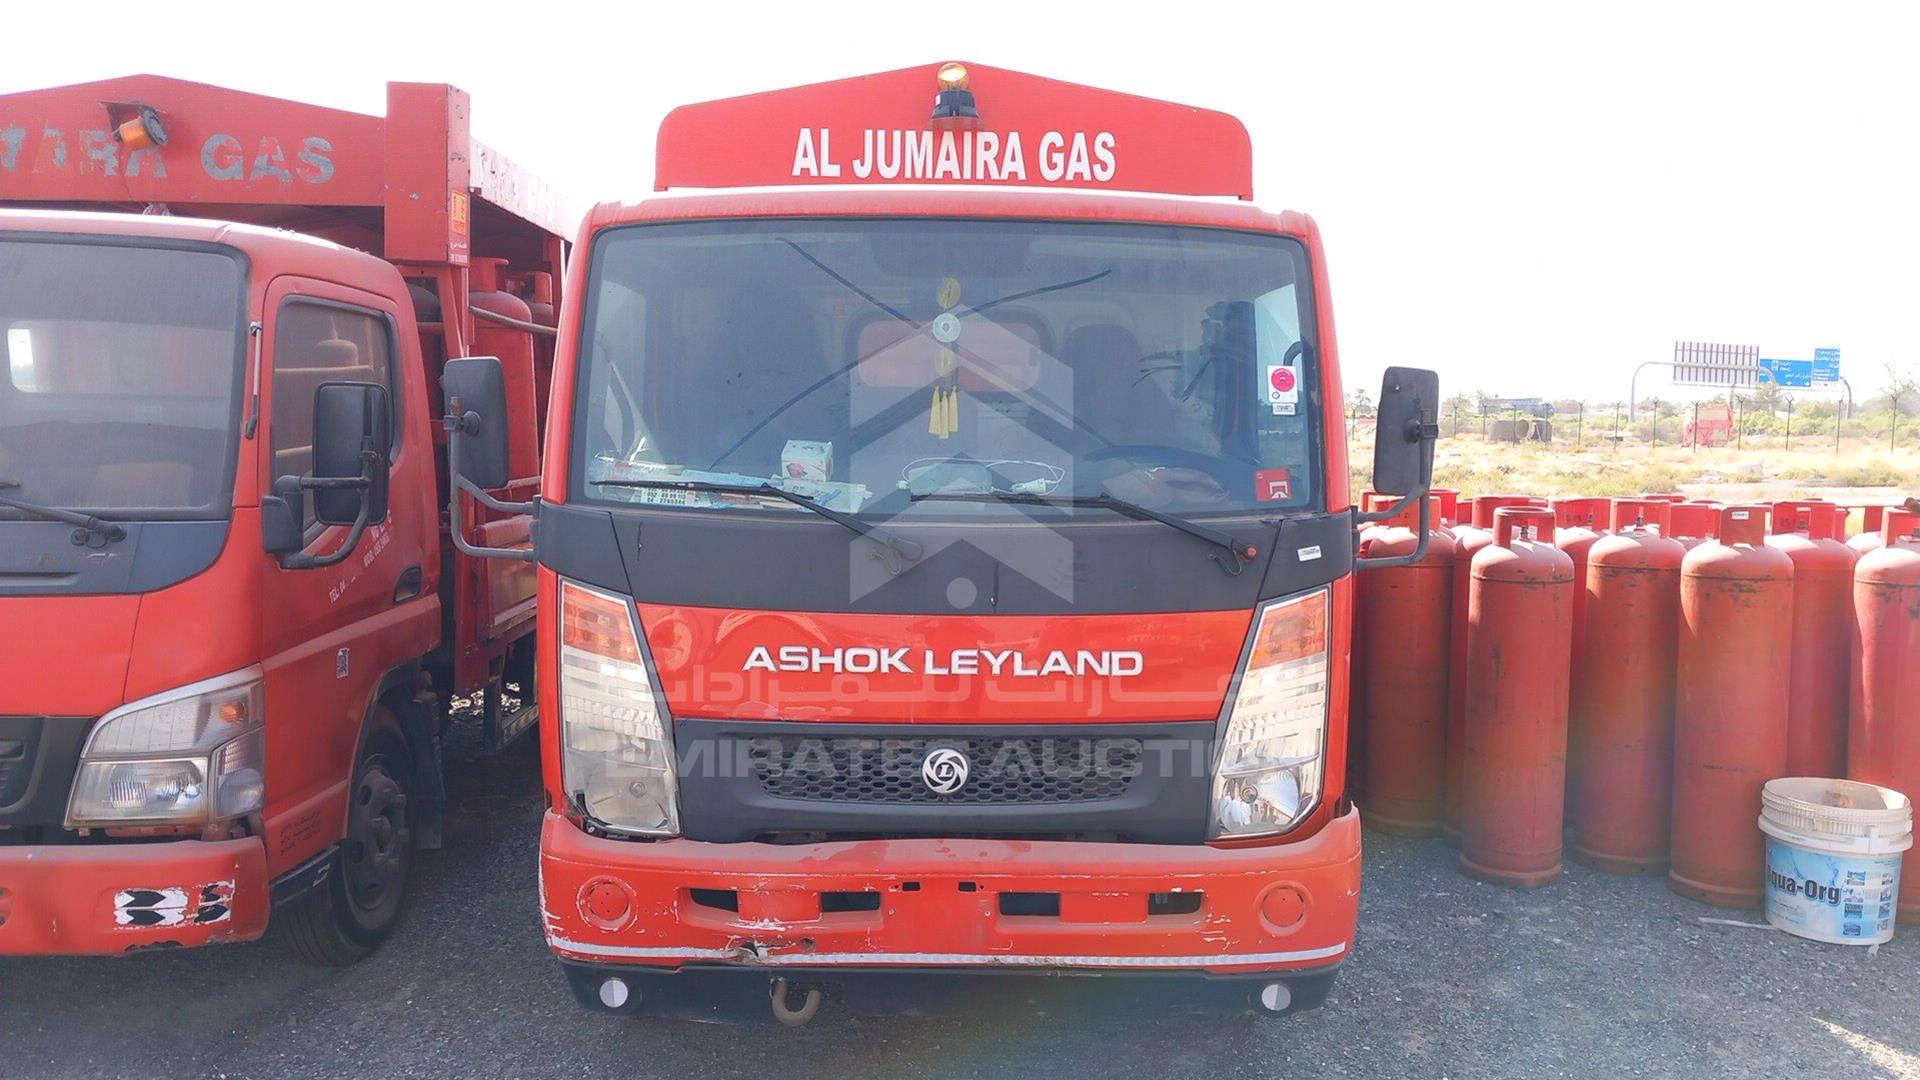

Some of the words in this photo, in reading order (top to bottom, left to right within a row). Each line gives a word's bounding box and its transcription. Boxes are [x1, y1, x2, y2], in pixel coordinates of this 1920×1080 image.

[201, 133, 336, 187] GAS
[791, 127, 841, 178] AL
[852, 128, 1027, 181] JUMAIRA
[1038, 130, 1118, 182] GAS
[740, 646, 913, 674] ASHOK
[924, 648, 1144, 677] LEYLAND
